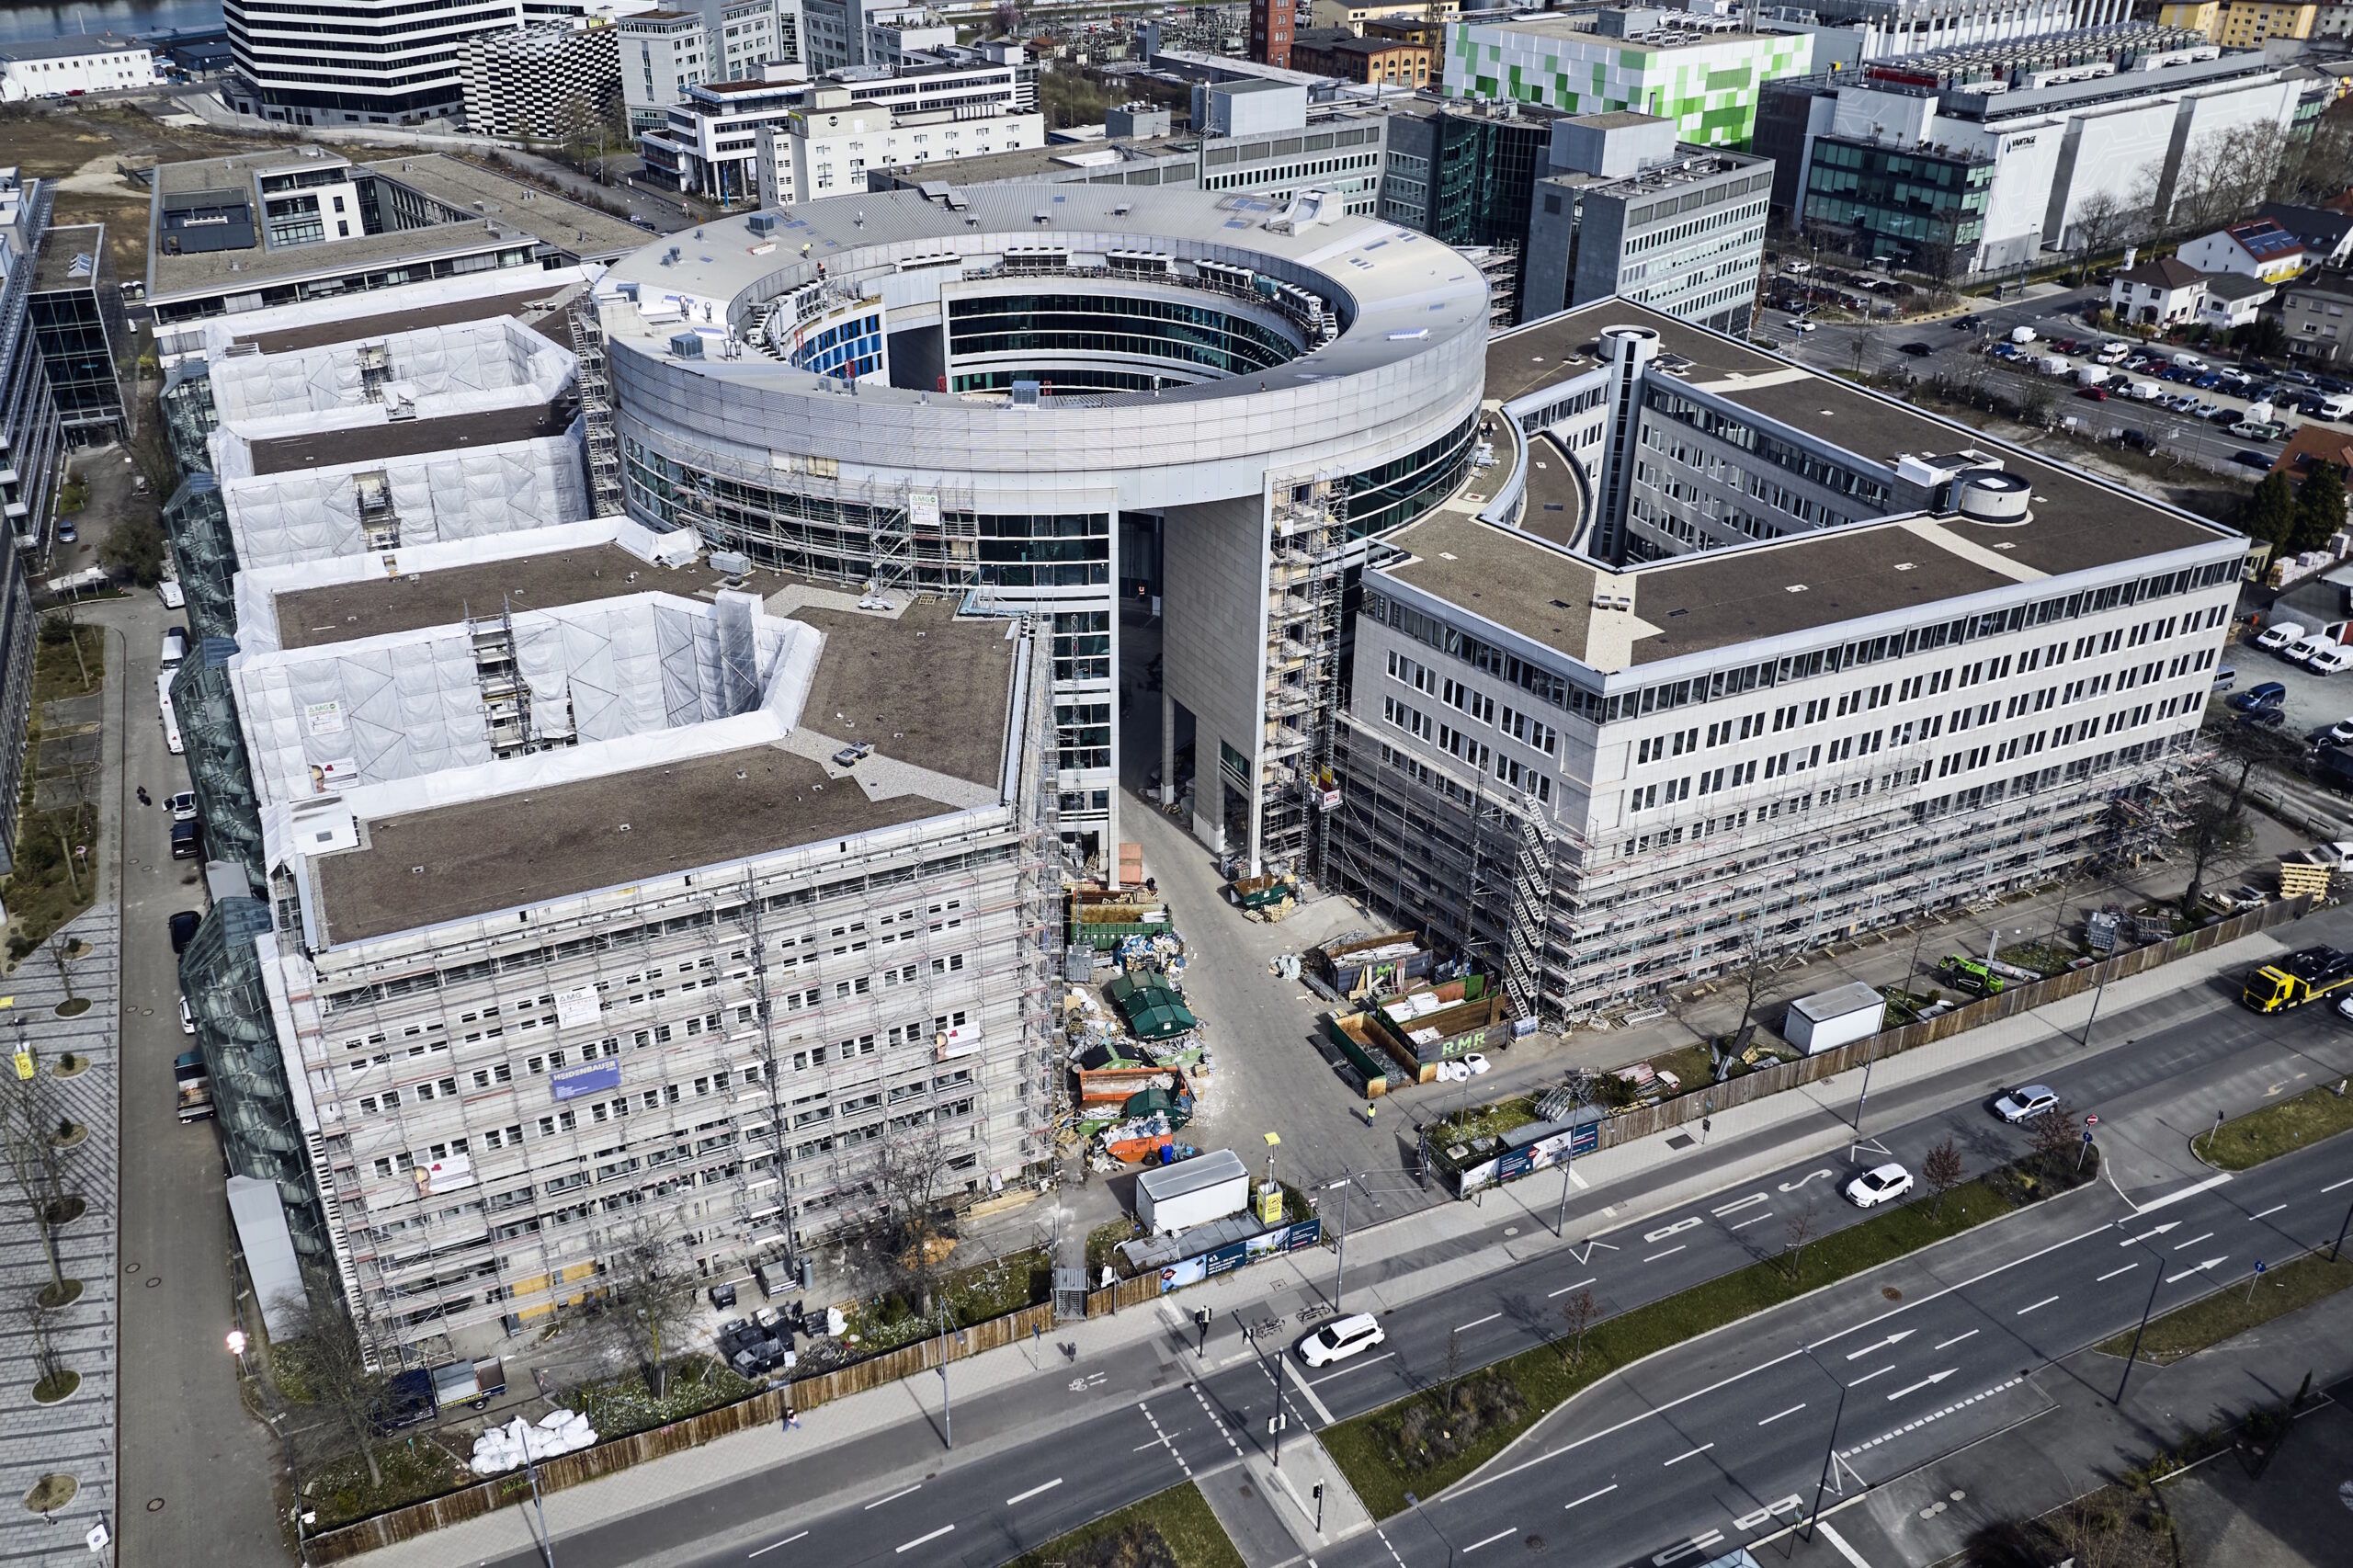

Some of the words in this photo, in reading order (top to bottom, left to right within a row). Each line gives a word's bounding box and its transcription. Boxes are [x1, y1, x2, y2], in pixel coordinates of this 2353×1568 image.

[2012, 135, 2037, 147] VANTAGE
[560, 992, 583, 1002] AMG
[1442, 1032, 1485, 1056] RMR
[553, 1060, 616, 1081] HEIDENBAUER
[1643, 1169, 1833, 1243] BUS
